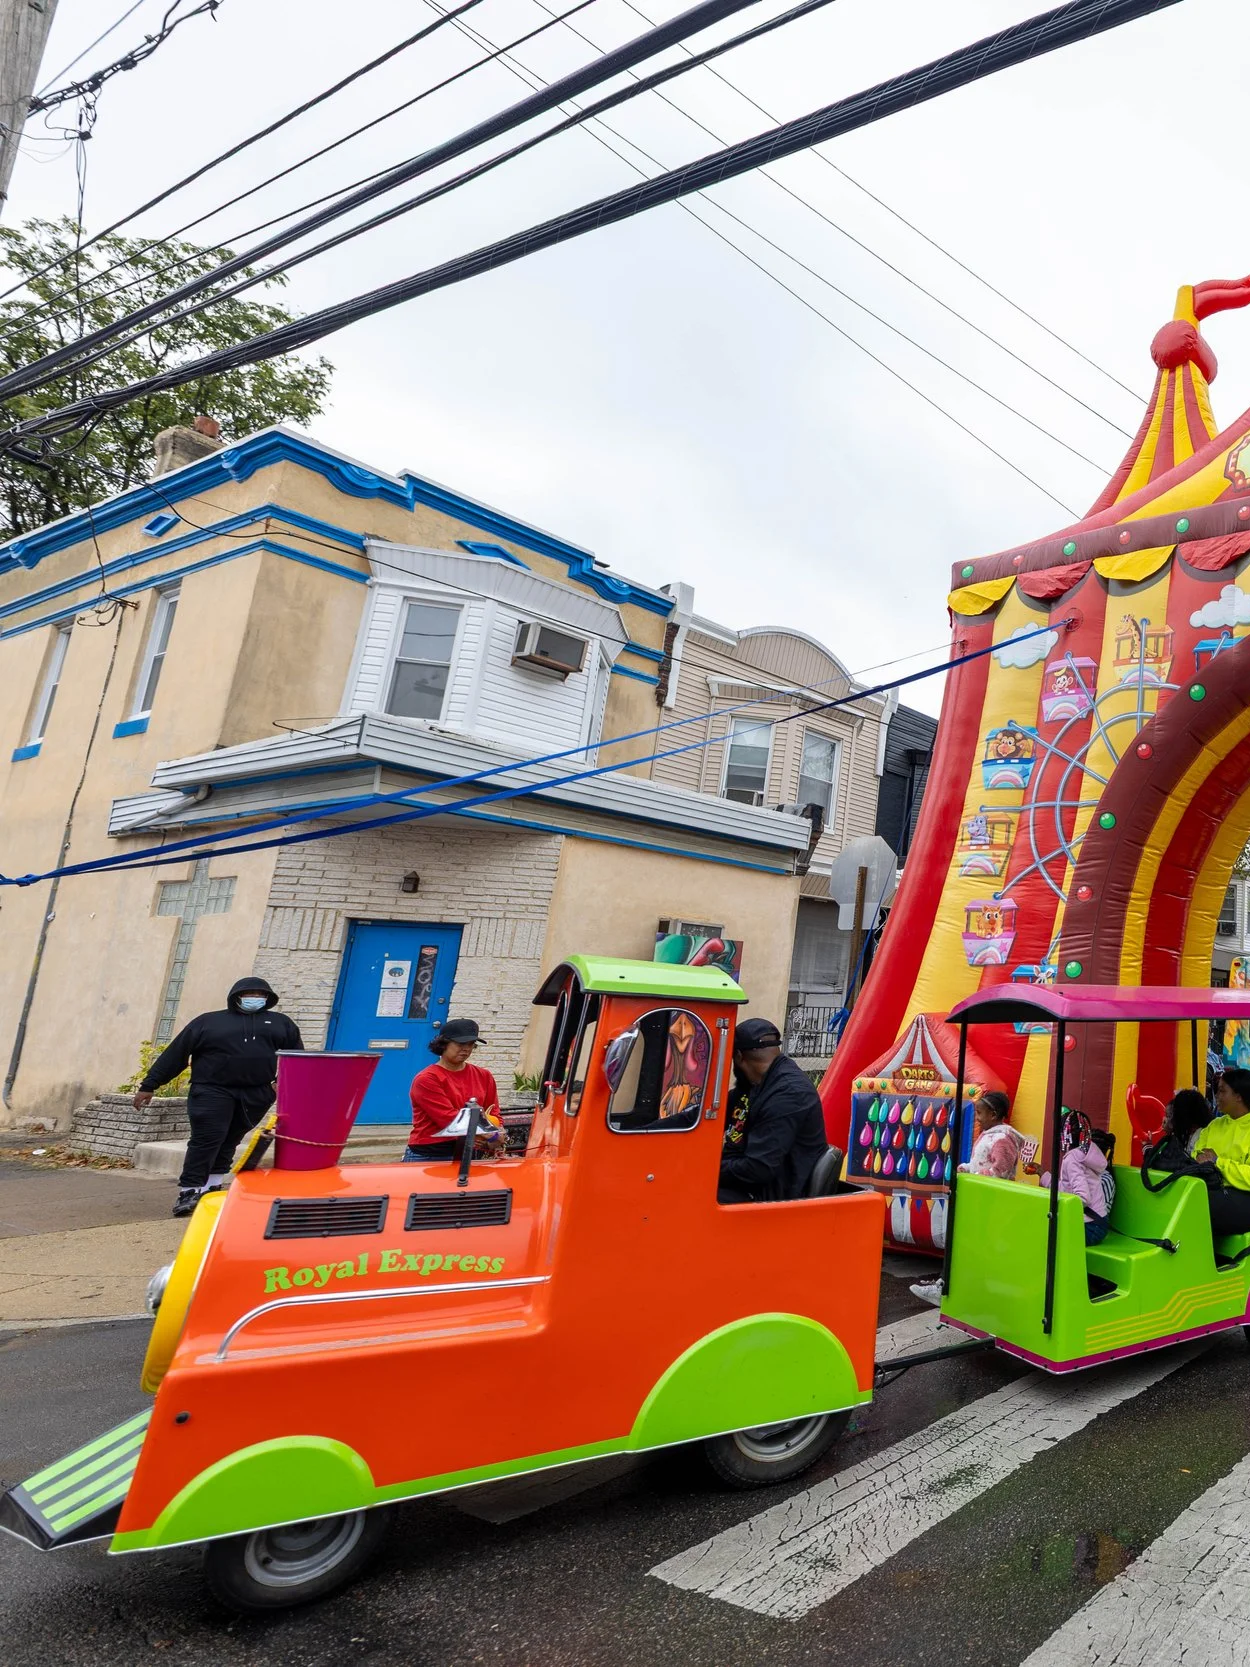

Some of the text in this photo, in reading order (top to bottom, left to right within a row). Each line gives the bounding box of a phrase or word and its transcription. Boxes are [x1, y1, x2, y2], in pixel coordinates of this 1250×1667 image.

[901, 1067, 936, 1080] DARTS
[904, 1079, 933, 1090] GAME
[264, 1248, 505, 1293] Royal Express
